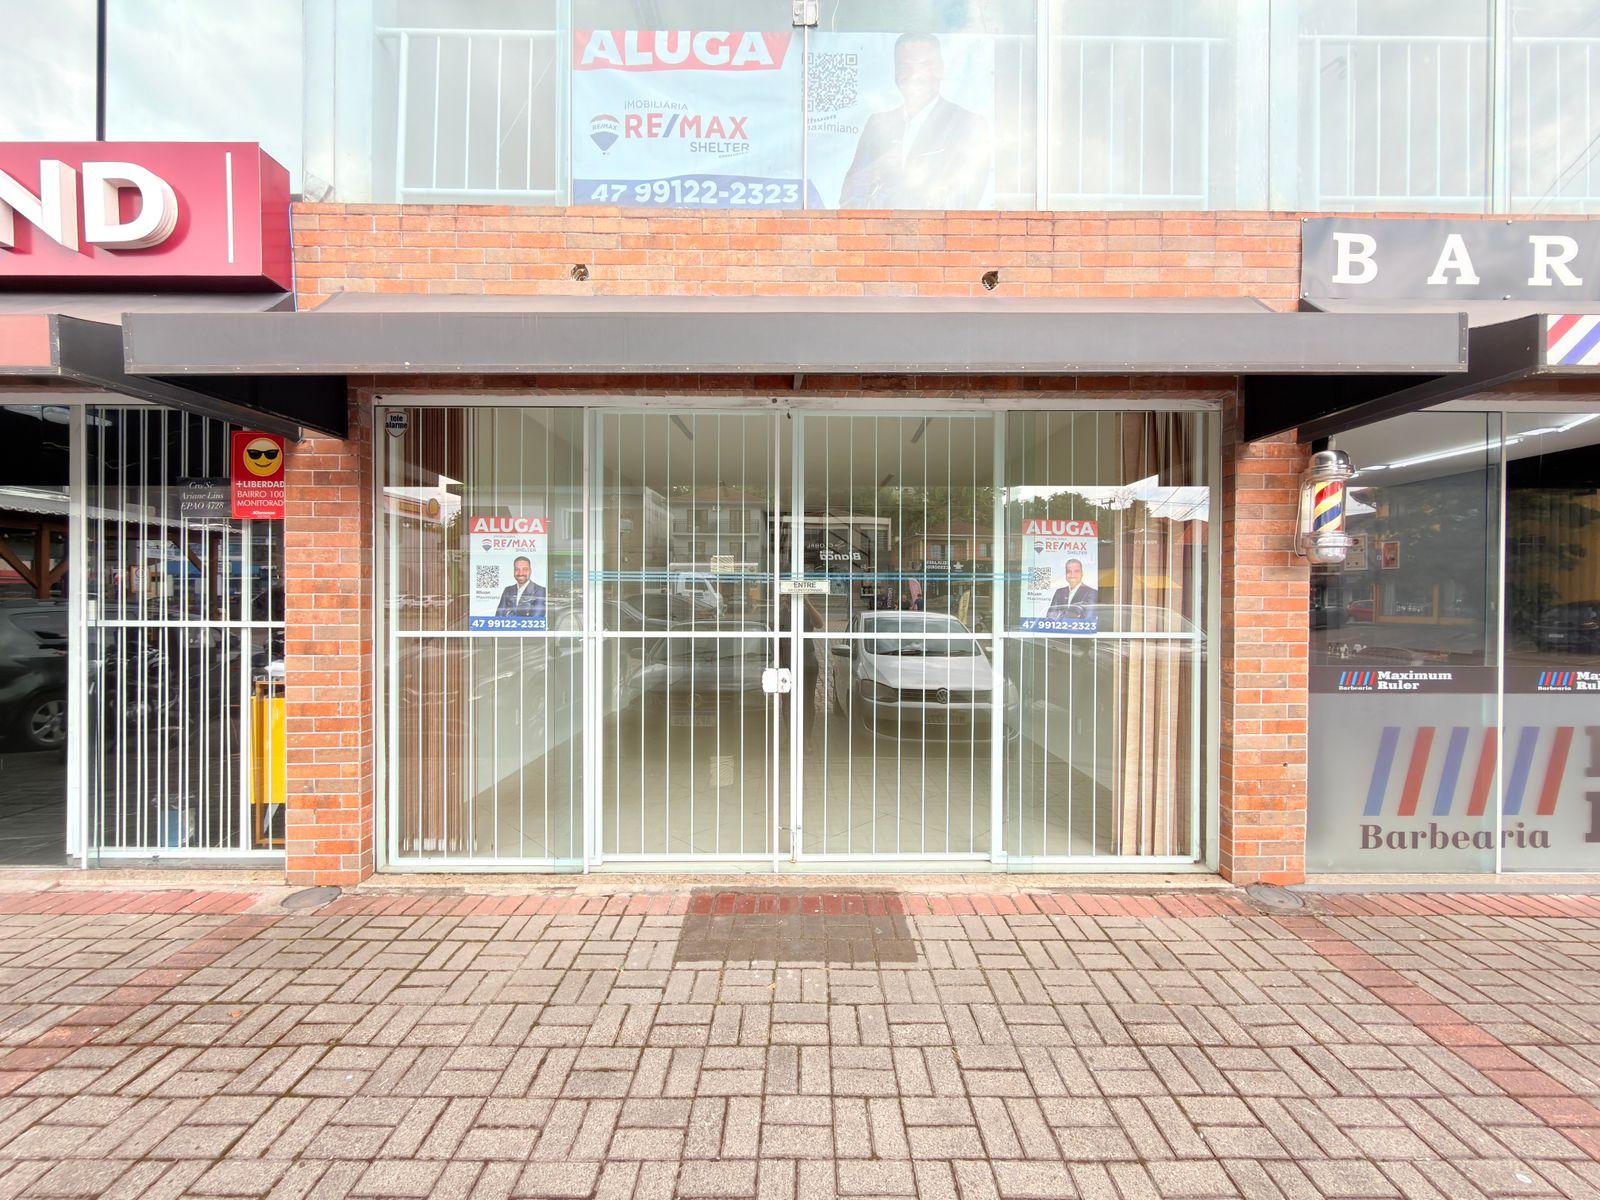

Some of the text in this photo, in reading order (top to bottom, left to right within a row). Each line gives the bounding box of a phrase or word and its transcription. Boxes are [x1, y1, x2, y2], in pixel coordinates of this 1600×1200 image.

[581, 30, 774, 66] ALUGA
[624, 113, 749, 140] RE/MAX
[690, 141, 750, 154] SHELTER
[591, 179, 799, 205] 47 99122-2323
[237, 490, 267, 499] BAIRRO
[474, 517, 544, 533] ALUGA
[1026, 520, 1095, 537] ALUGA
[493, 539, 536, 548] RE/MAX
[1045, 542, 1087, 551] RE/MAX
[472, 619, 545, 628] 47 99122-2323
[1022, 621, 1097, 631] 47 99122-2323
[1377, 671, 1452, 680] Maximum
[1377, 680, 1420, 690] Ruler
[1359, 822, 1551, 850] Barbearia
